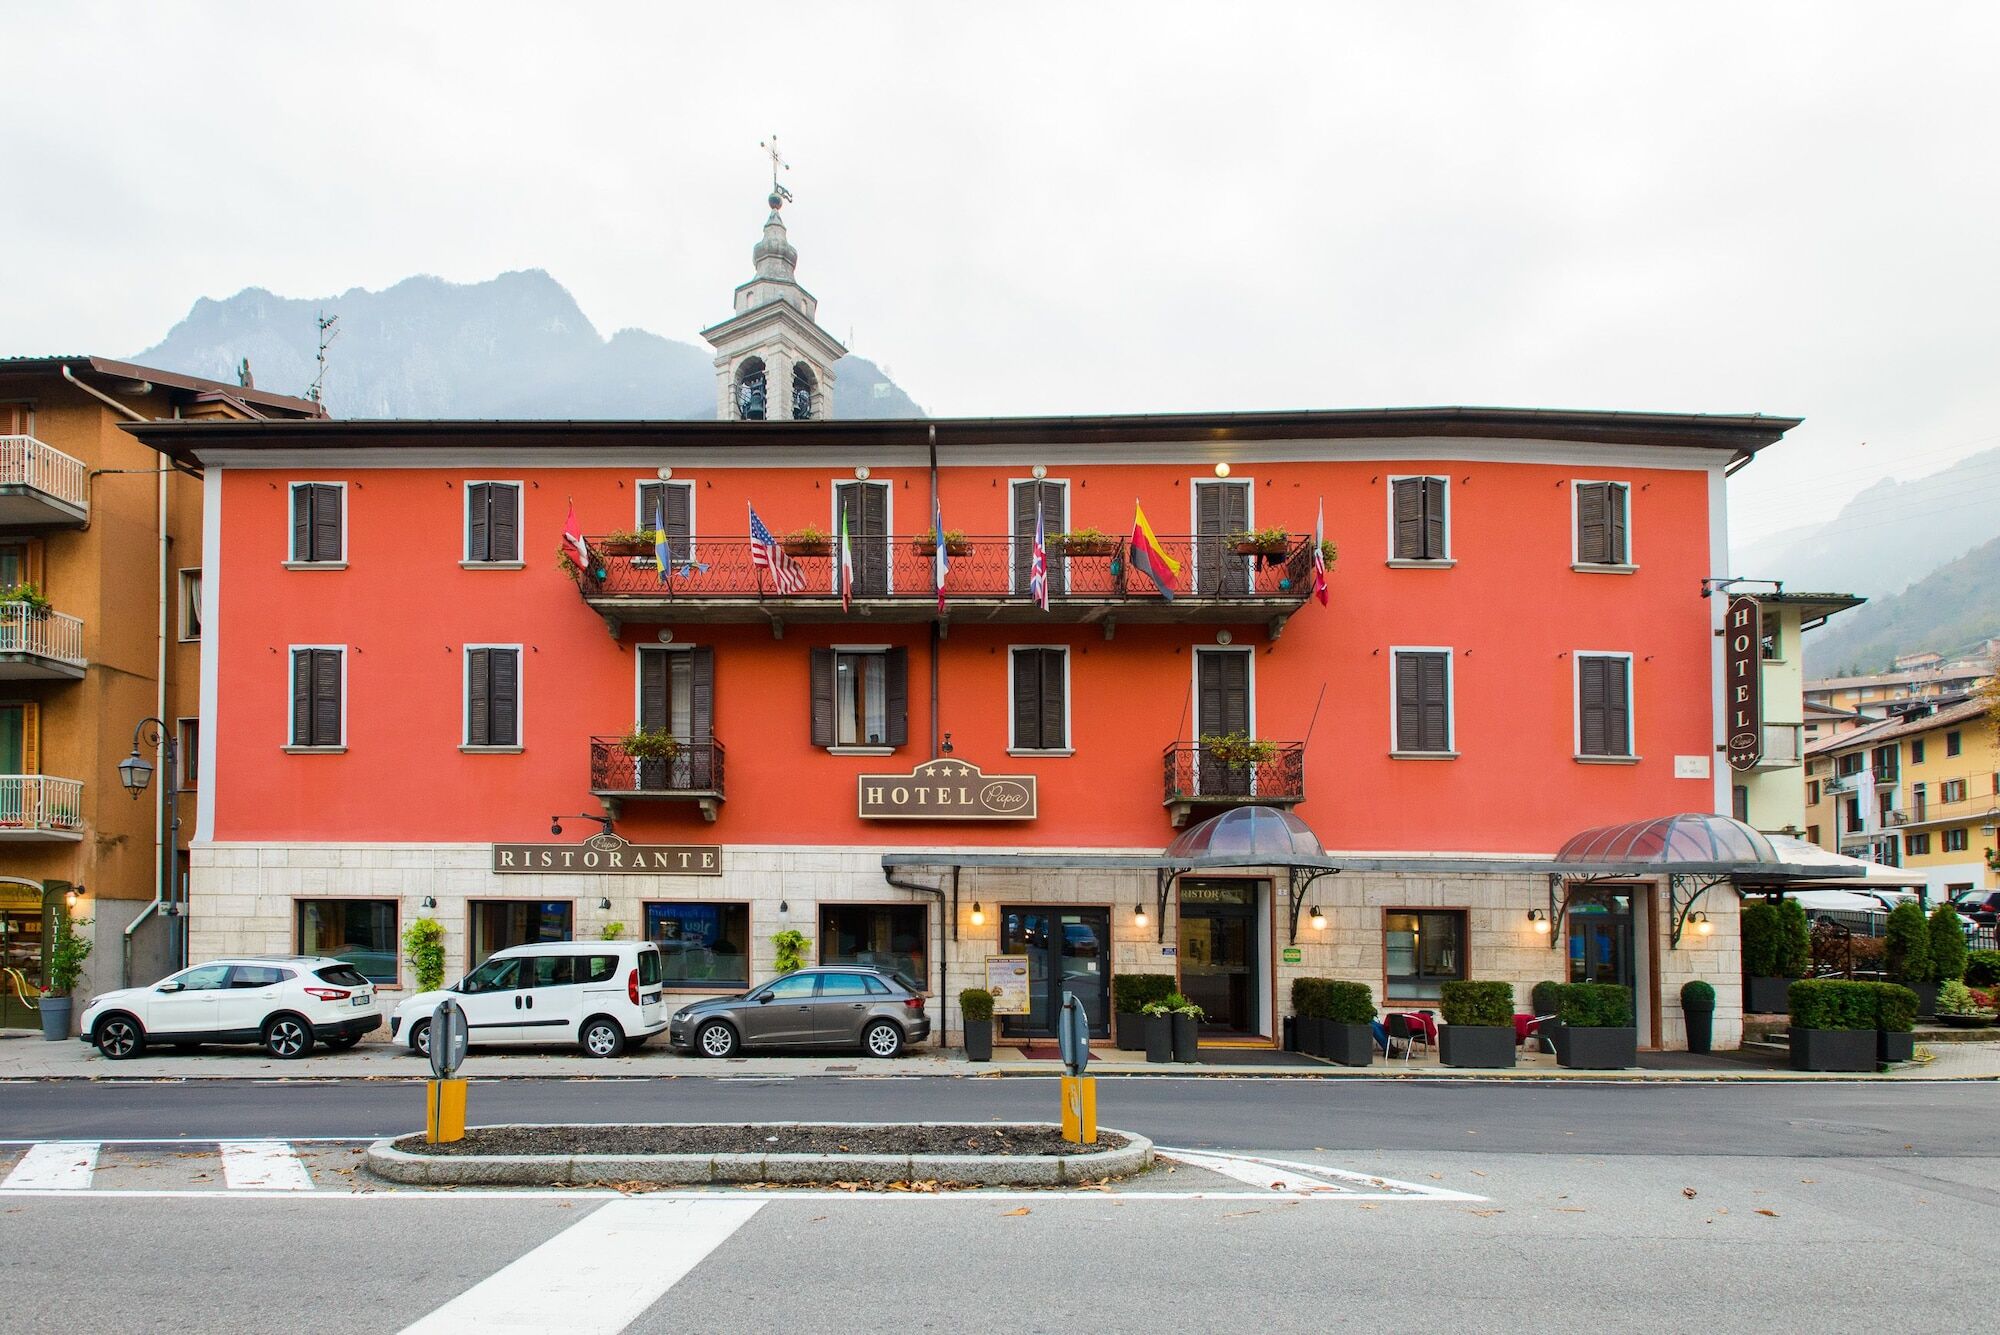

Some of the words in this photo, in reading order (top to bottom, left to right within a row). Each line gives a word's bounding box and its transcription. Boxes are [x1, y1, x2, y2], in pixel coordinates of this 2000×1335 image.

[1734, 608, 1750, 728] HOTEL
[866, 787, 974, 805] HOTEL
[986, 785, 1023, 808] Papa
[501, 851, 715, 868] RISTORANTE
[1181, 889, 1243, 898] RISTORANT
